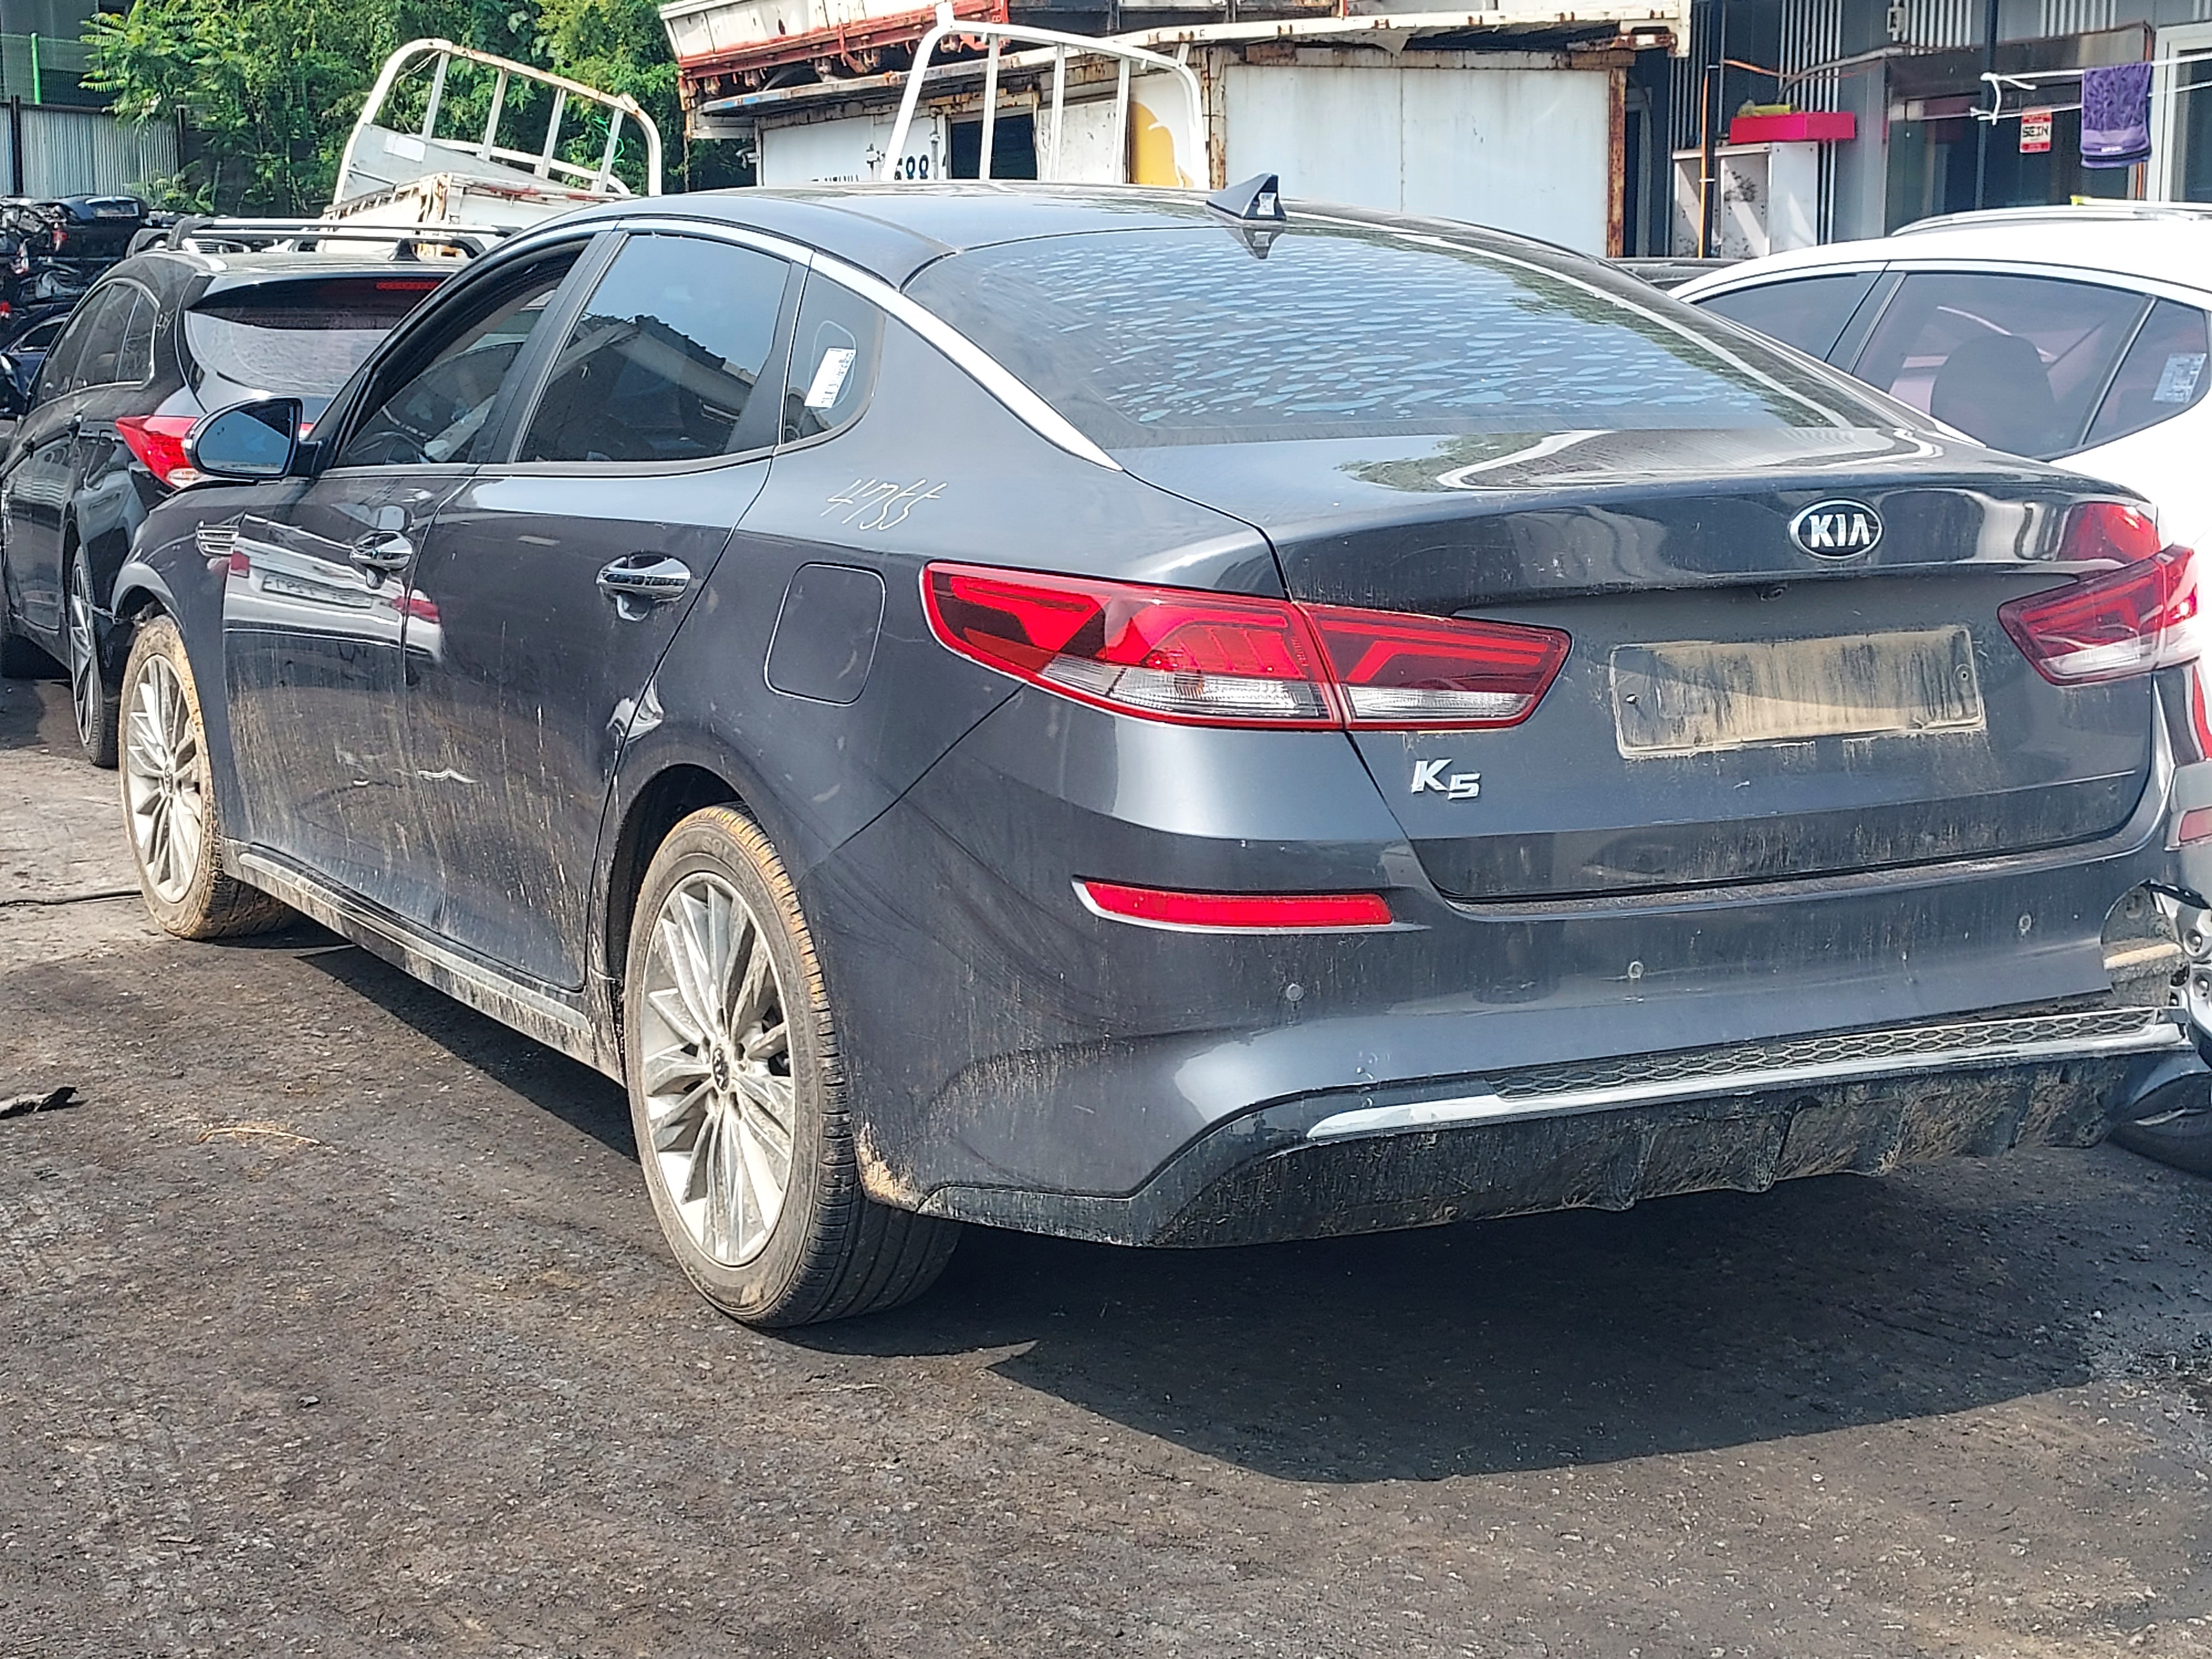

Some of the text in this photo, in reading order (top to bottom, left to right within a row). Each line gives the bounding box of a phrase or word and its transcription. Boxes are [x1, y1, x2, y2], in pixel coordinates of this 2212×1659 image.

[821, 478, 947, 530] 4755
[1809, 514, 1870, 547] KIA
[1411, 759, 1481, 800] K5
